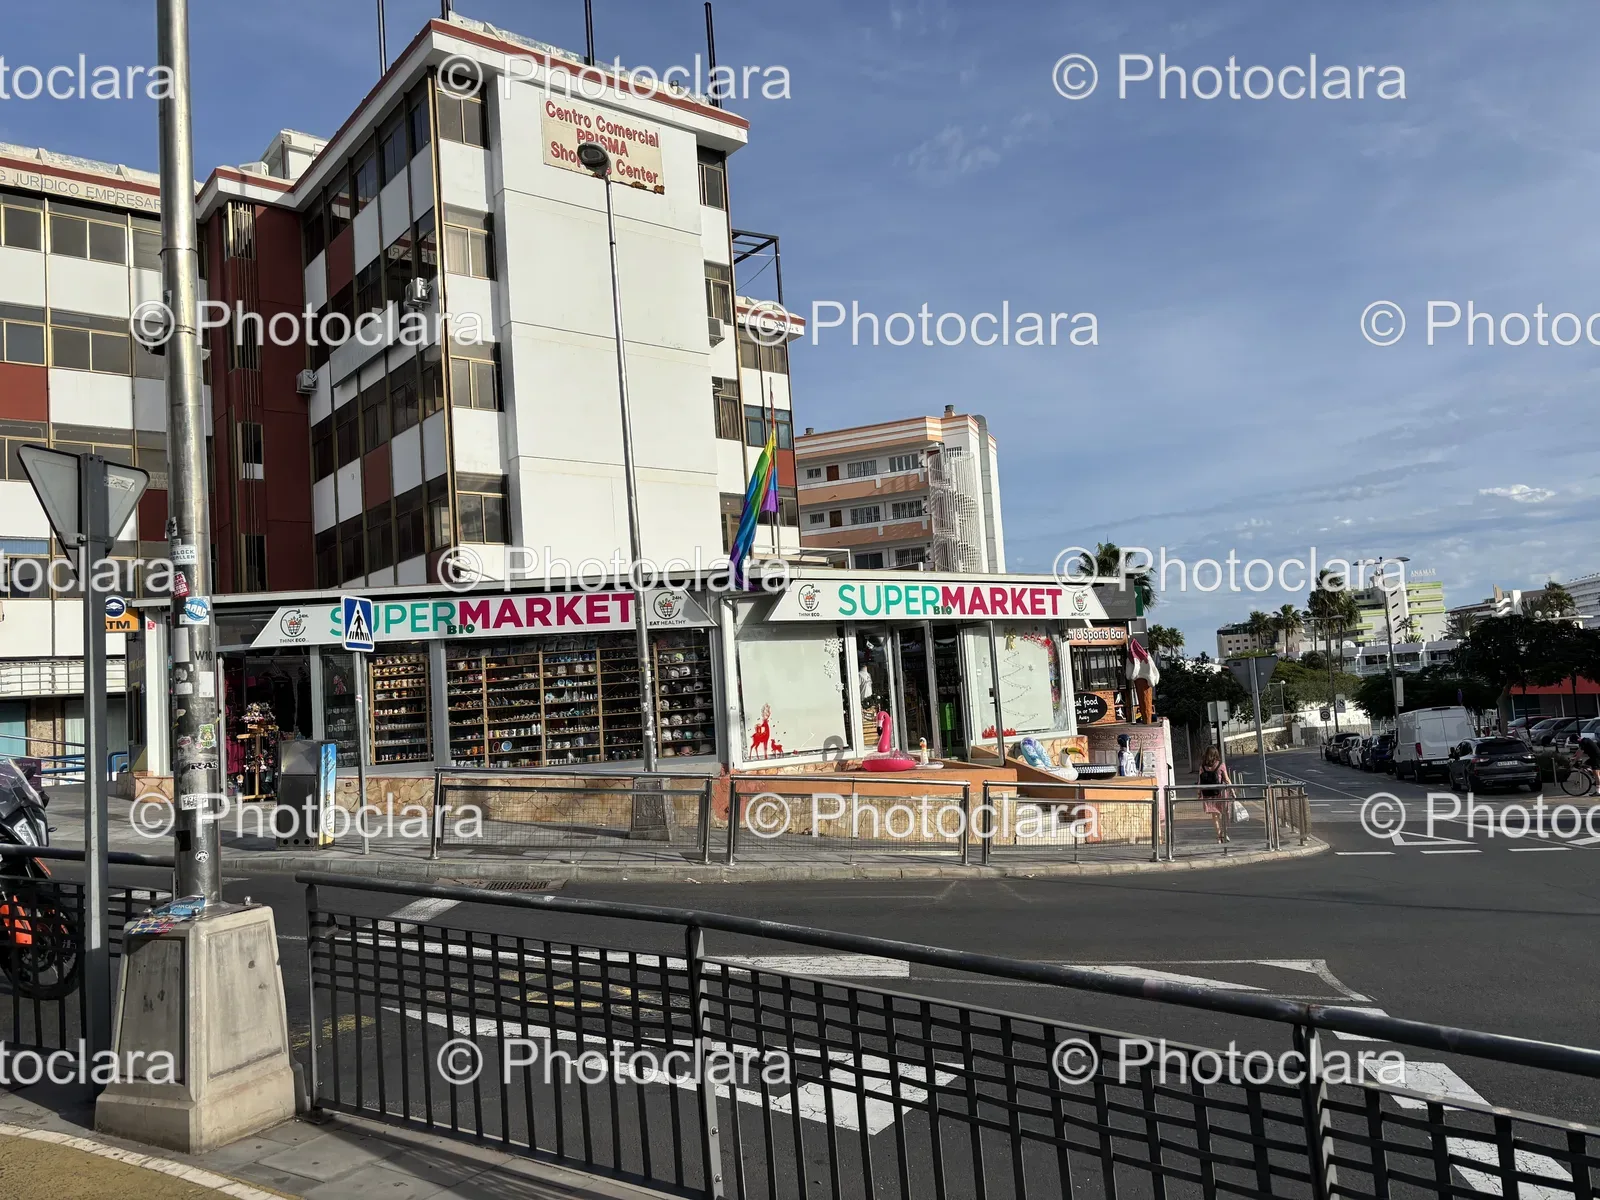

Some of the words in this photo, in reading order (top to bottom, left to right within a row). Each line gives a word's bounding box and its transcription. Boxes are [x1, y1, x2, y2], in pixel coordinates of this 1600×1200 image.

[545, 100, 592, 129] Centro
[596, 115, 660, 148] Comercial
[616, 158, 659, 185] Center
[838, 583, 1062, 616] SUPERMARKET
[933, 605, 953, 615] BIO
[447, 624, 475, 635] BIO
[1076, 629, 1082, 639] &
[1083, 628, 1108, 643] Sports
[1110, 629, 1124, 639] Bar
[195, 651, 213, 661] W10
[1083, 695, 1099, 708] food
